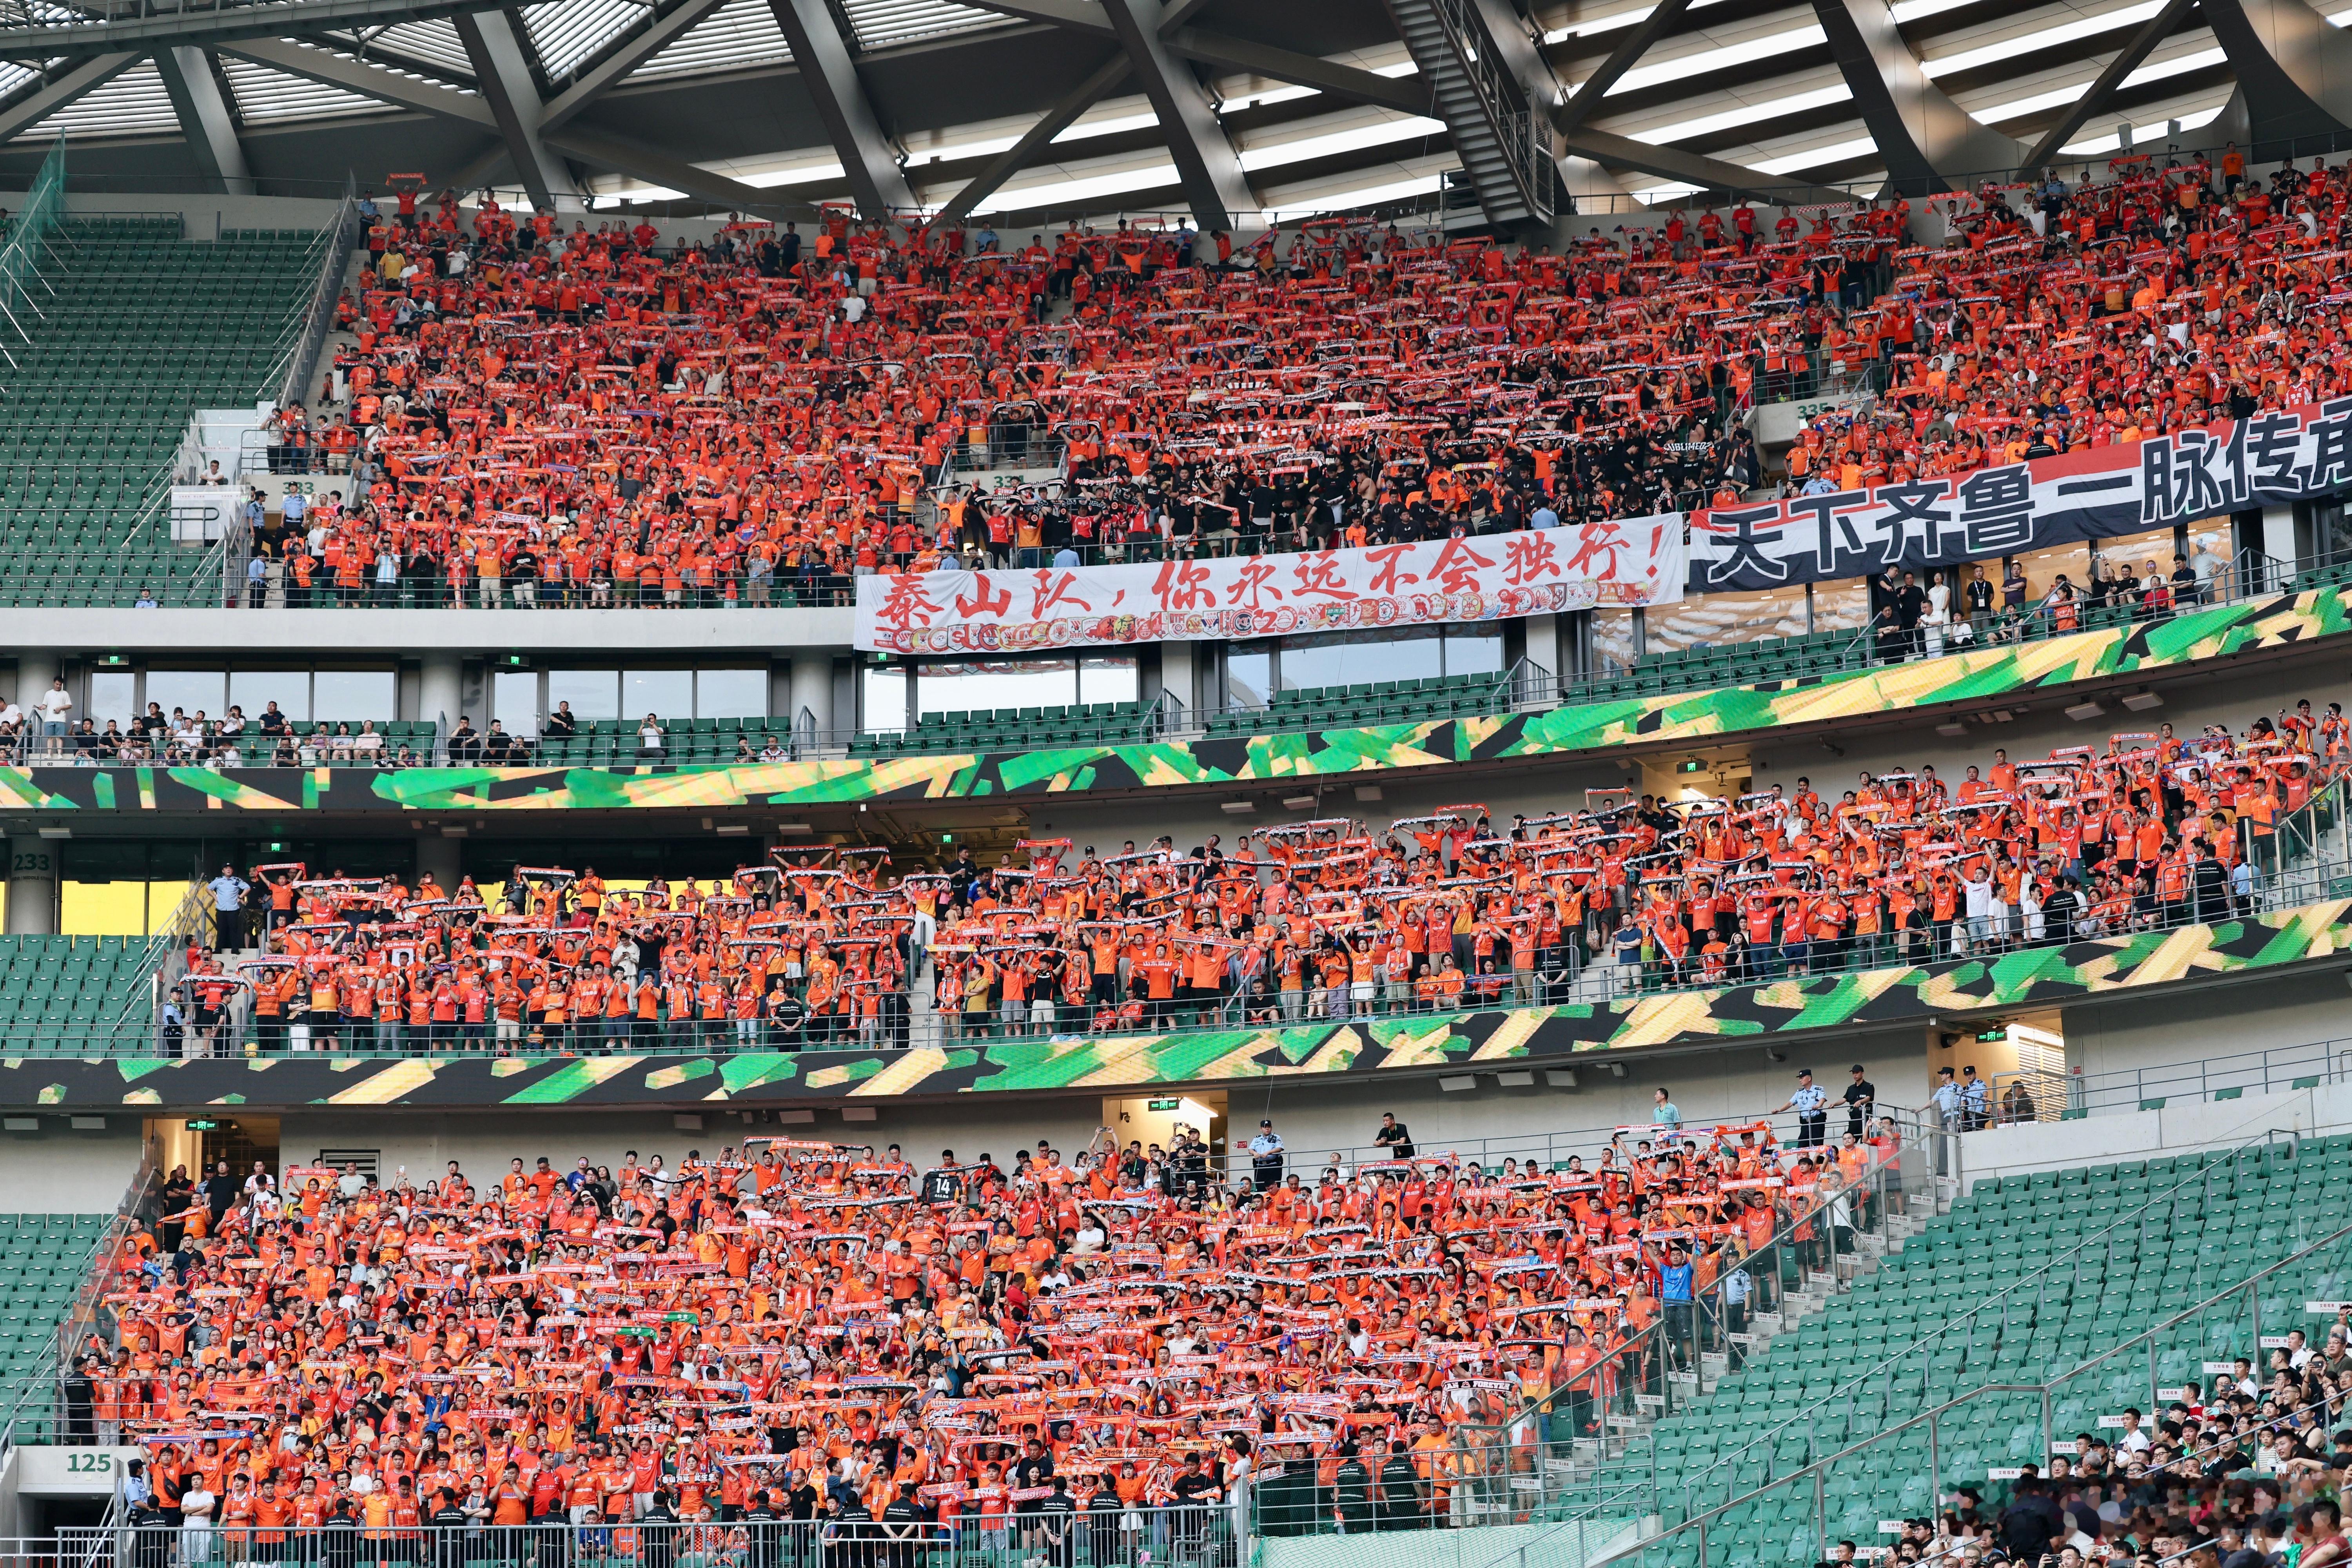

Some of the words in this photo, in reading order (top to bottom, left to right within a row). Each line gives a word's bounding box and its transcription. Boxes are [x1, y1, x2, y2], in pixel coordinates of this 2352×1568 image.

[2317, 251, 2344, 260] 山东泰山
[877, 523, 1662, 628] 泰山队，你永远不会独行！
[14, 853, 49, 870] 233
[936, 1178, 950, 1194] 14
[483, 1230, 514, 1239] 山东泰山
[1472, 1380, 1509, 1390] FOREVER
[1230, 1419, 1242, 1429] 12
[613, 1425, 639, 1434] 泰山为证
[1122, 1448, 1136, 1458] 12
[67, 1454, 112, 1472] 125
[662, 1474, 690, 1483] 泰山为证
